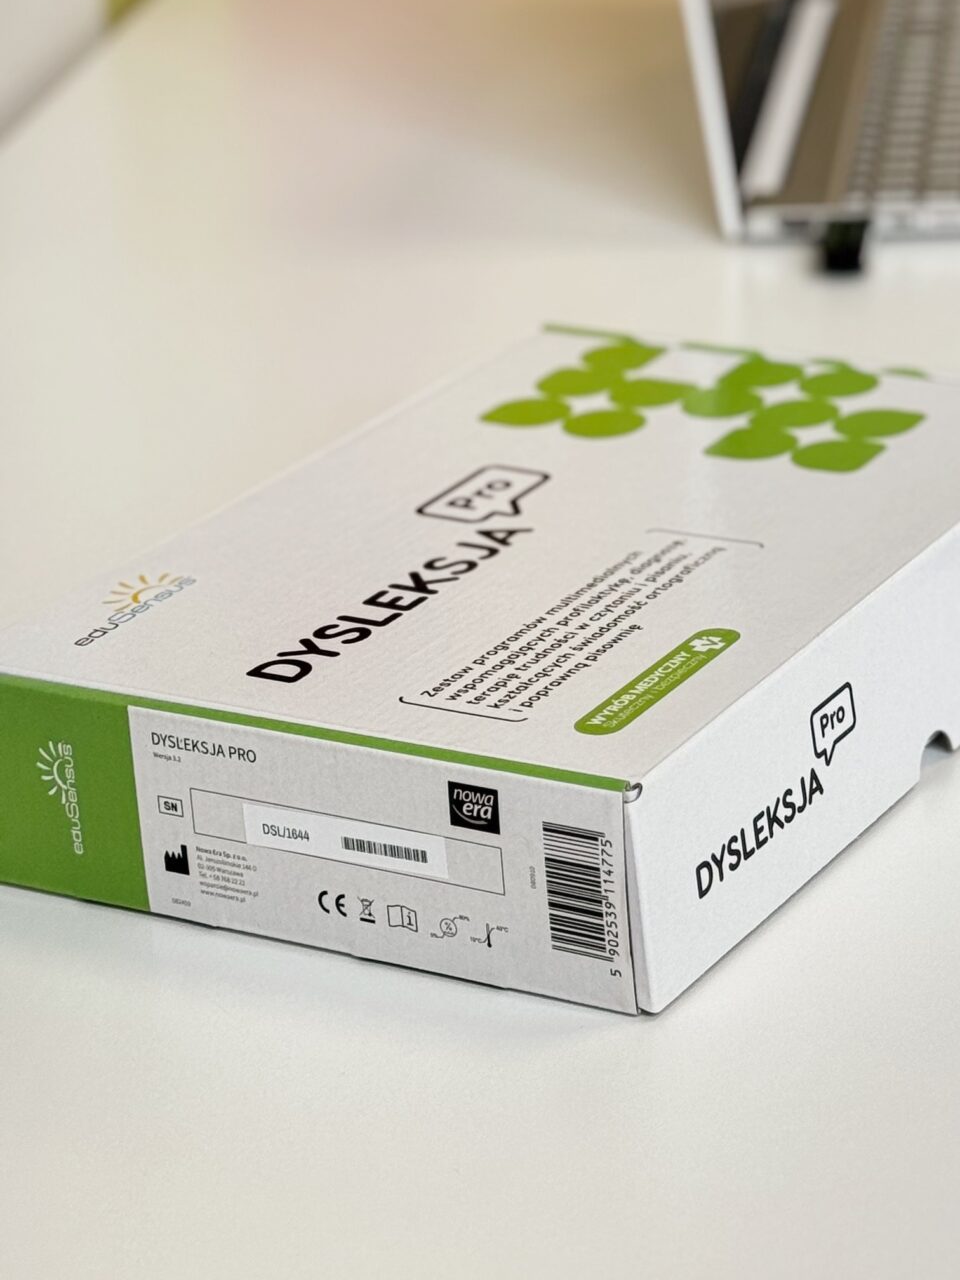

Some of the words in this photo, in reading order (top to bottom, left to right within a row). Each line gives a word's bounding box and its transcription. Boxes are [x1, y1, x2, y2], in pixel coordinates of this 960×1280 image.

[446, 479, 513, 510] Pro
[74, 576, 197, 646] eduSensus
[246, 527, 534, 683] DYSLEKSJA
[420, 666, 474, 697] Zestaw
[472, 616, 547, 665] programów
[545, 550, 643, 616] multimedialnych
[445, 626, 559, 701] wspomagających
[466, 672, 521, 705] terapię
[514, 632, 579, 671] trudności
[575, 622, 590, 631] w
[589, 587, 642, 622] czytaniu
[486, 652, 575, 708] kształcących
[569, 600, 648, 651] świadomość
[521, 662, 592, 708] poprawną
[585, 624, 644, 661] pisownię
[586, 693, 637, 725] WYRÓB
[631, 650, 691, 694] MEDYCZNY
[819, 706, 845, 738] Pro
[228, 746, 257, 763] PRO
[63, 743, 84, 855] eduSensus
[164, 801, 178, 812] SN
[262, 823, 310, 842] DSL/1644
[453, 788, 494, 806] nowa
[462, 802, 492, 820] era
[696, 768, 824, 899] DYSLEKSJA
[610, 968, 622, 978] 5
